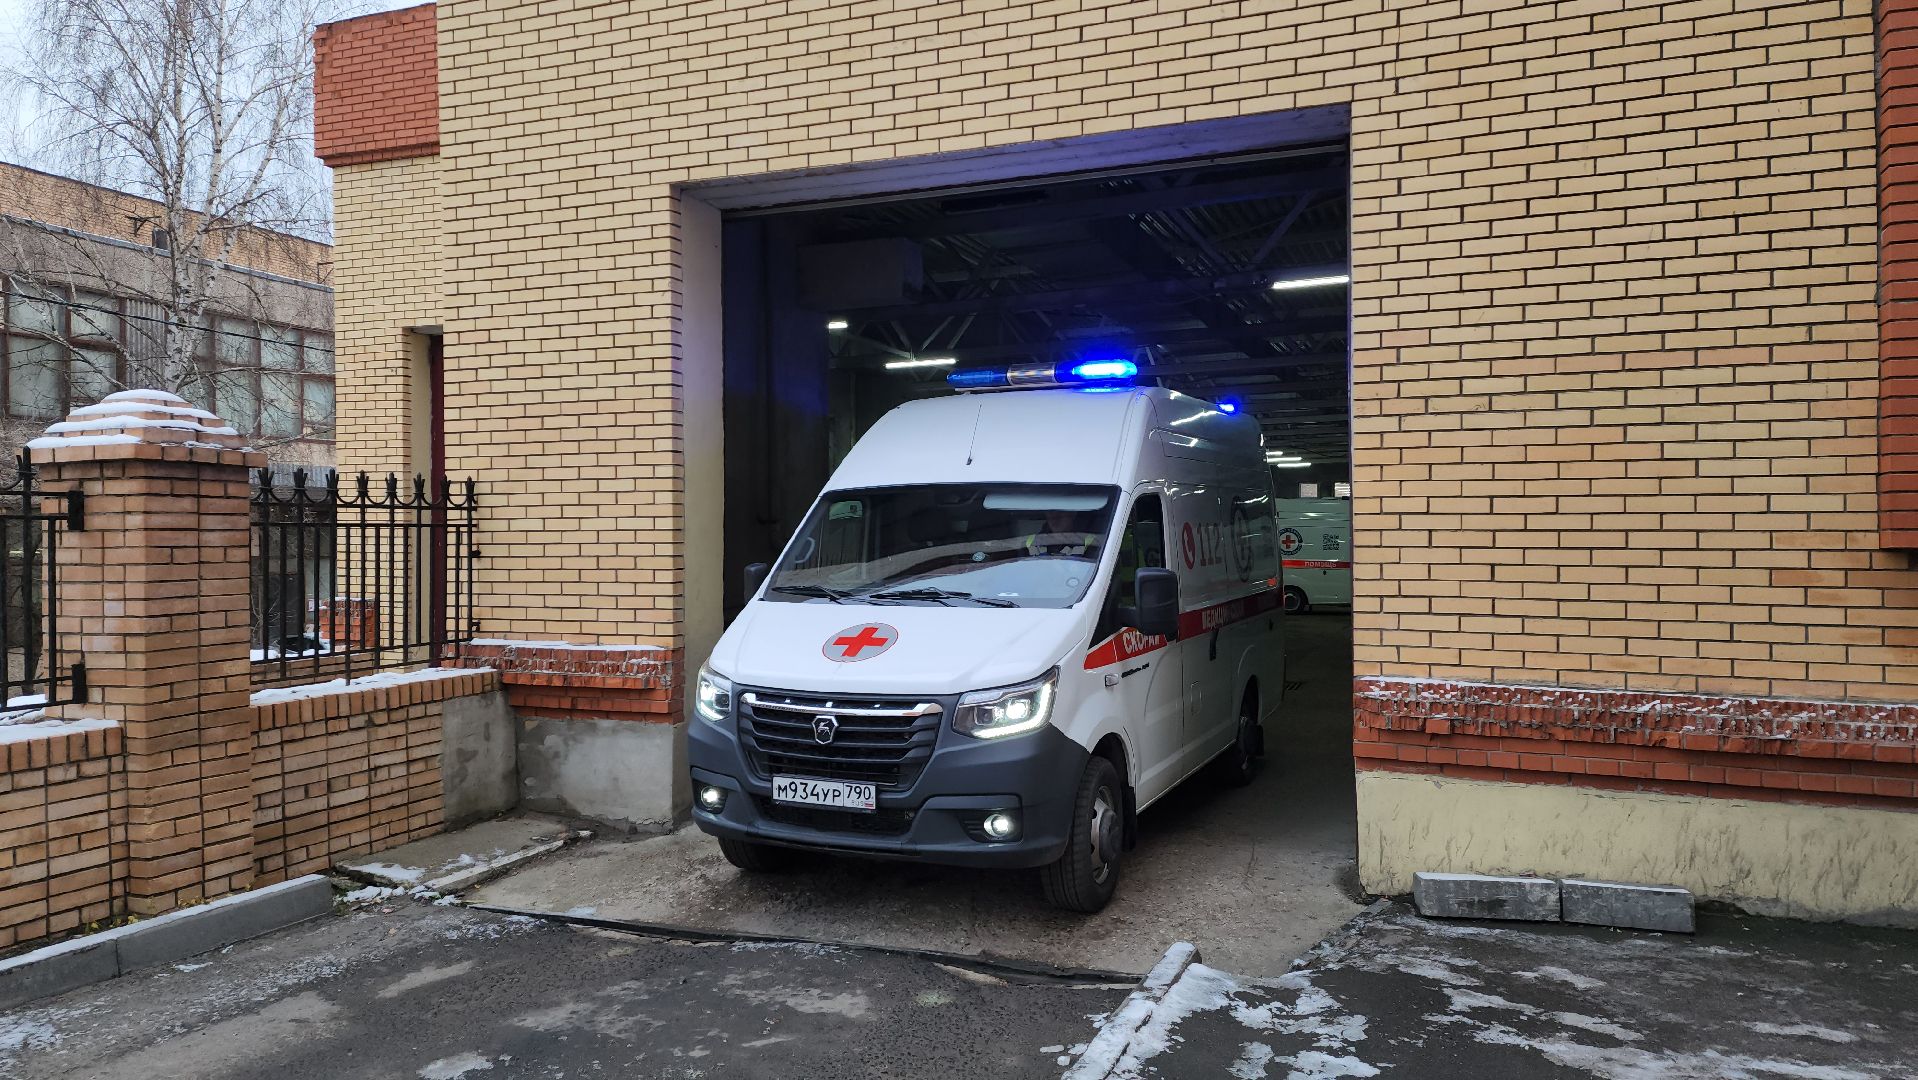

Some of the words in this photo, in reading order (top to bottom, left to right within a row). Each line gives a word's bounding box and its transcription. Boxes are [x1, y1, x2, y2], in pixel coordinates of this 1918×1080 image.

[1197, 522, 1222, 567] 112
[1304, 561, 1337, 569] ПОМОЩЬ
[777, 781, 841, 803] М934УР
[845, 784, 871, 800] 790
